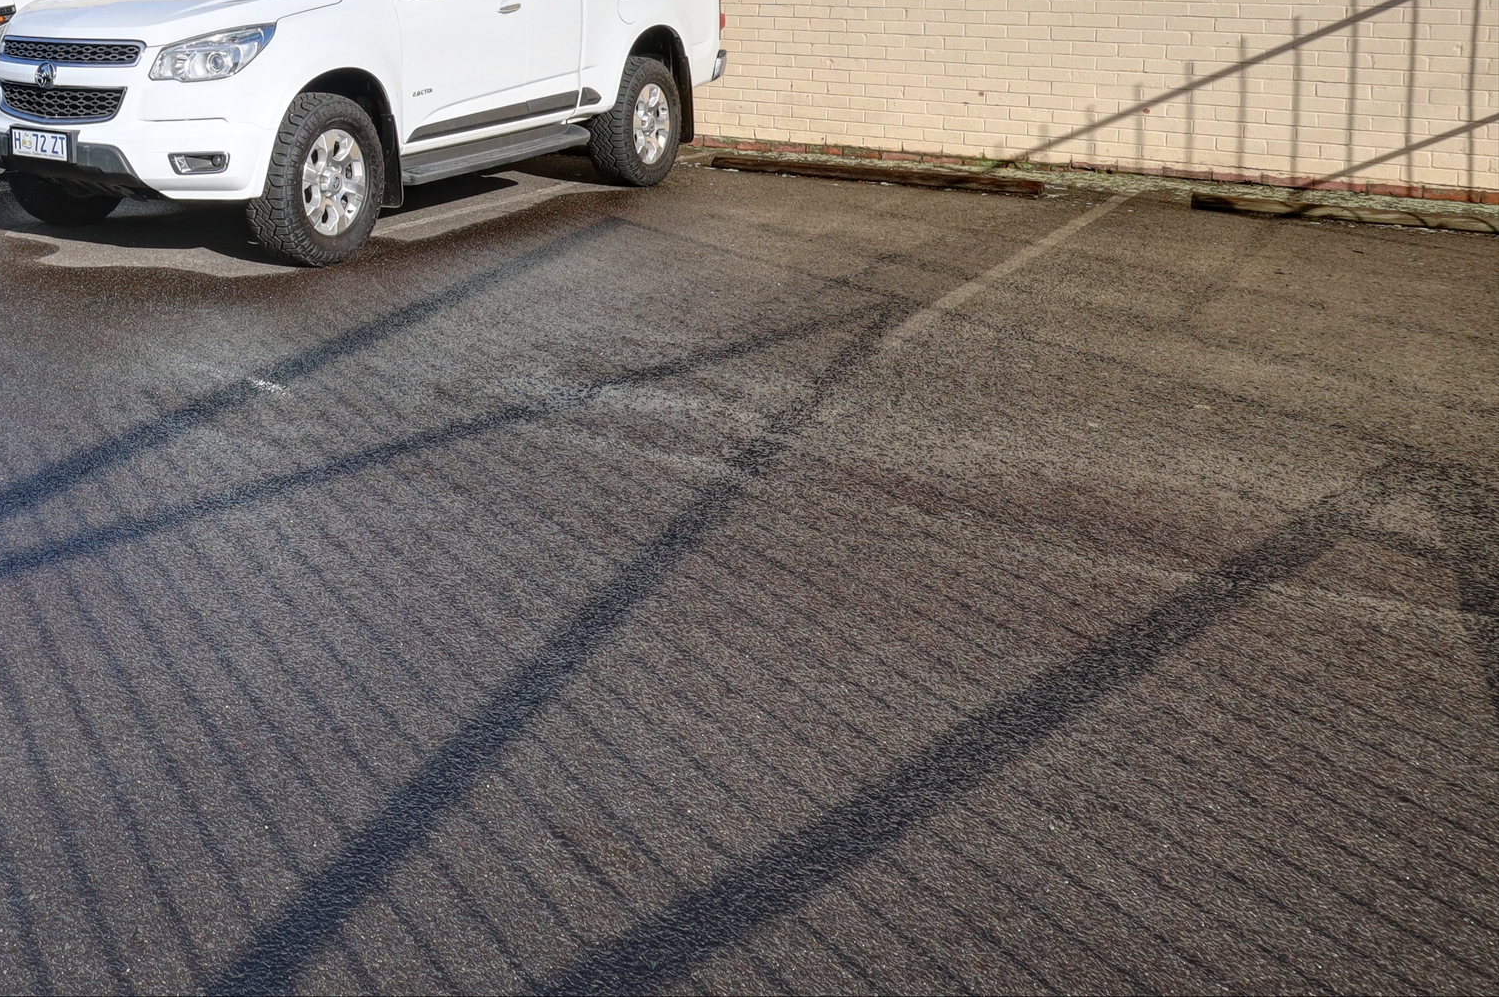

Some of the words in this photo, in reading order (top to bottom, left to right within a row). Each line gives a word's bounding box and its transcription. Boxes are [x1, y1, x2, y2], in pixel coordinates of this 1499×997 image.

[13, 131, 22, 150] H
[32, 133, 48, 153] 72
[51, 135, 66, 155] ZT
